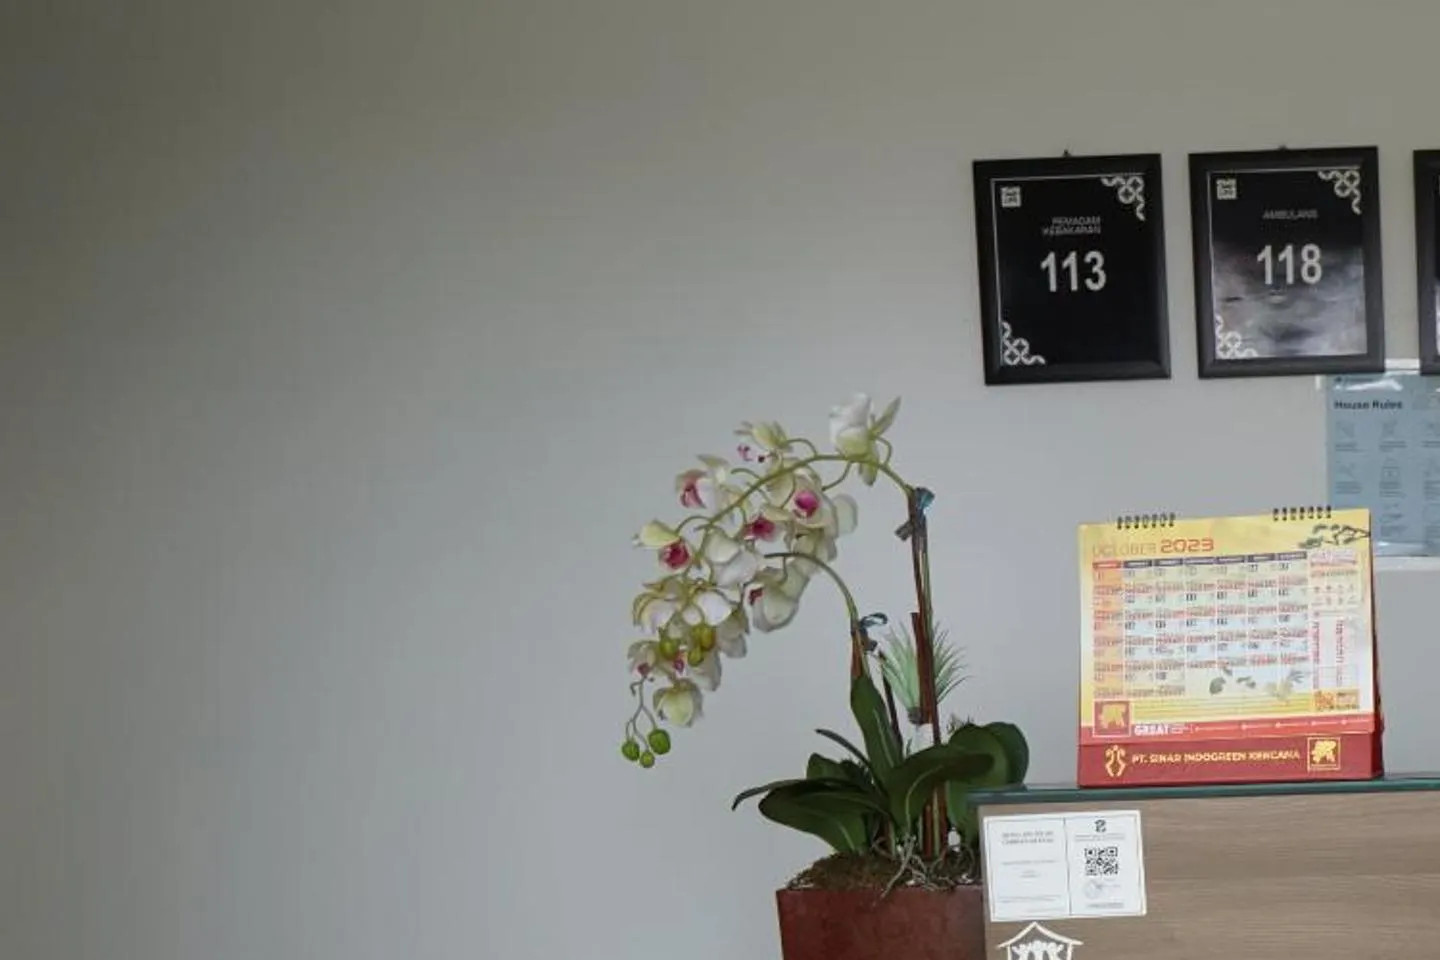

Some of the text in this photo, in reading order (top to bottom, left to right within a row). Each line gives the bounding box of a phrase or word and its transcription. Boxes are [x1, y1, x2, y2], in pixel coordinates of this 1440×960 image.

[1040, 250, 1107, 292] 113
[1256, 243, 1322, 285] 118
[1334, 399, 1403, 410] House Rules
[1160, 537, 1216, 554] 2023
